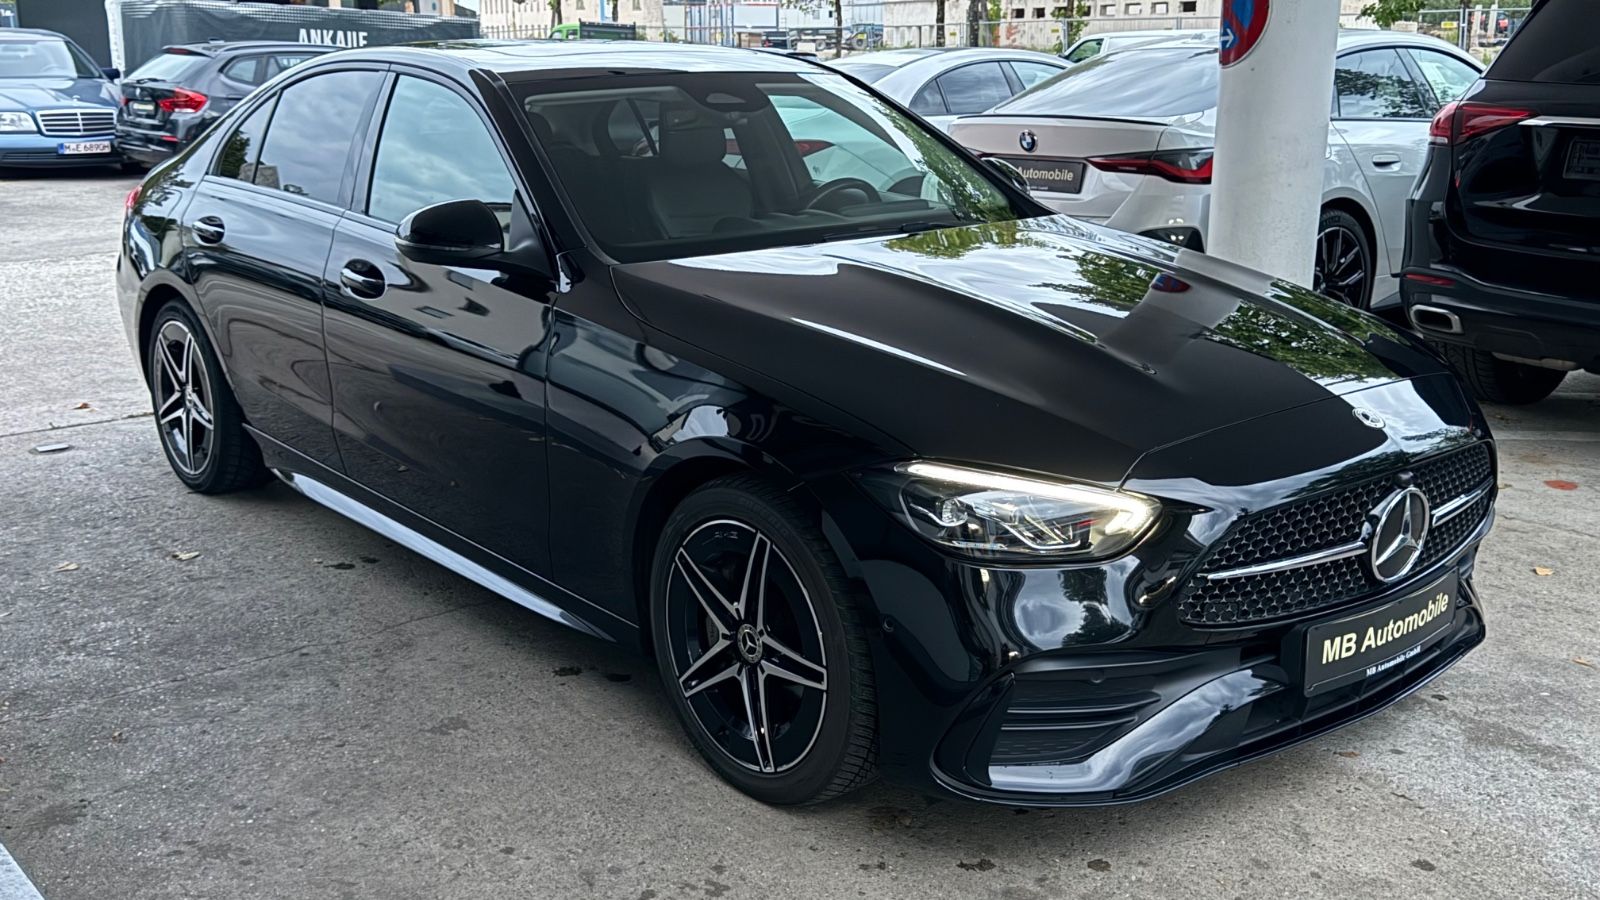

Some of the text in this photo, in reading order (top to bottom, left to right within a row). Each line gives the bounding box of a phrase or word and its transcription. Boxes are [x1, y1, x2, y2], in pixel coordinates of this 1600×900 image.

[299, 28, 368, 48] ANKAUF
[1322, 592, 1449, 665] MB Automobile
[1366, 666, 1377, 677] MB
[1377, 654, 1406, 672] Automobile
